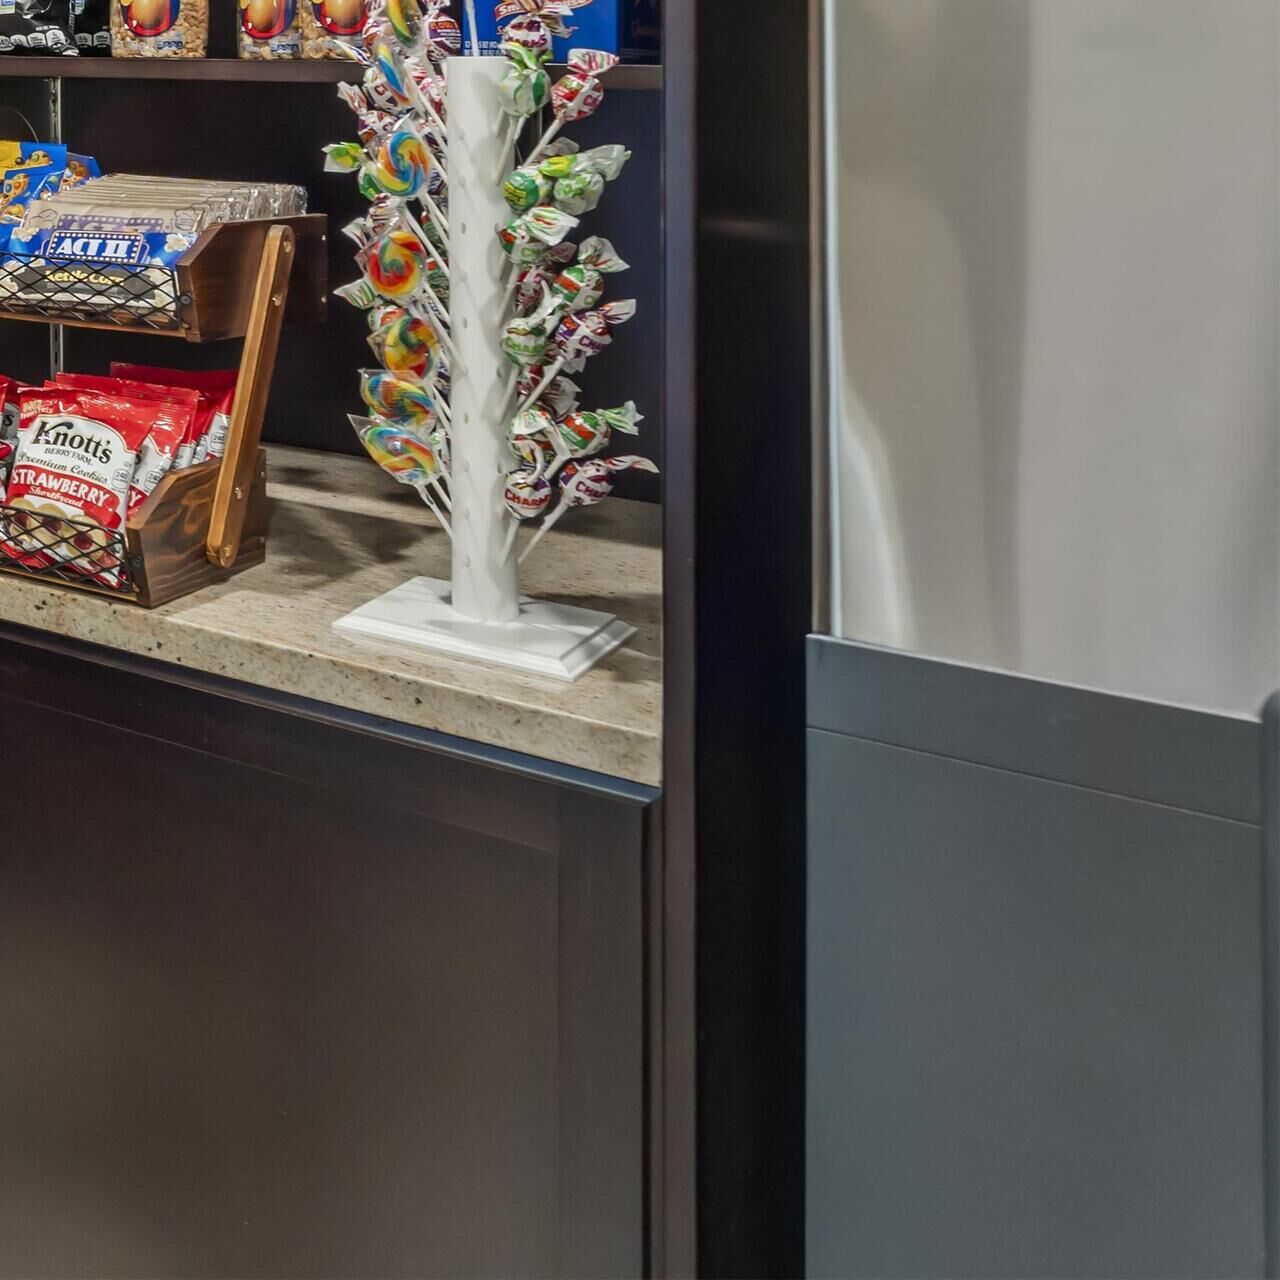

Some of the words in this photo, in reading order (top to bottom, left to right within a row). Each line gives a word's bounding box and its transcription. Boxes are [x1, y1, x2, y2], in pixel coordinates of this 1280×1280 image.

[57, 236, 99, 256] ACT
[100, 237, 130, 258] II
[32, 421, 112, 464] Knott's
[44, 447, 70, 458] BERRY
[70, 452, 93, 465] FARM
[18, 451, 68, 472] Premium
[68, 463, 109, 484] Cookies
[13, 468, 110, 508] STRAWBERRY
[29, 486, 85, 508] Shortbread
